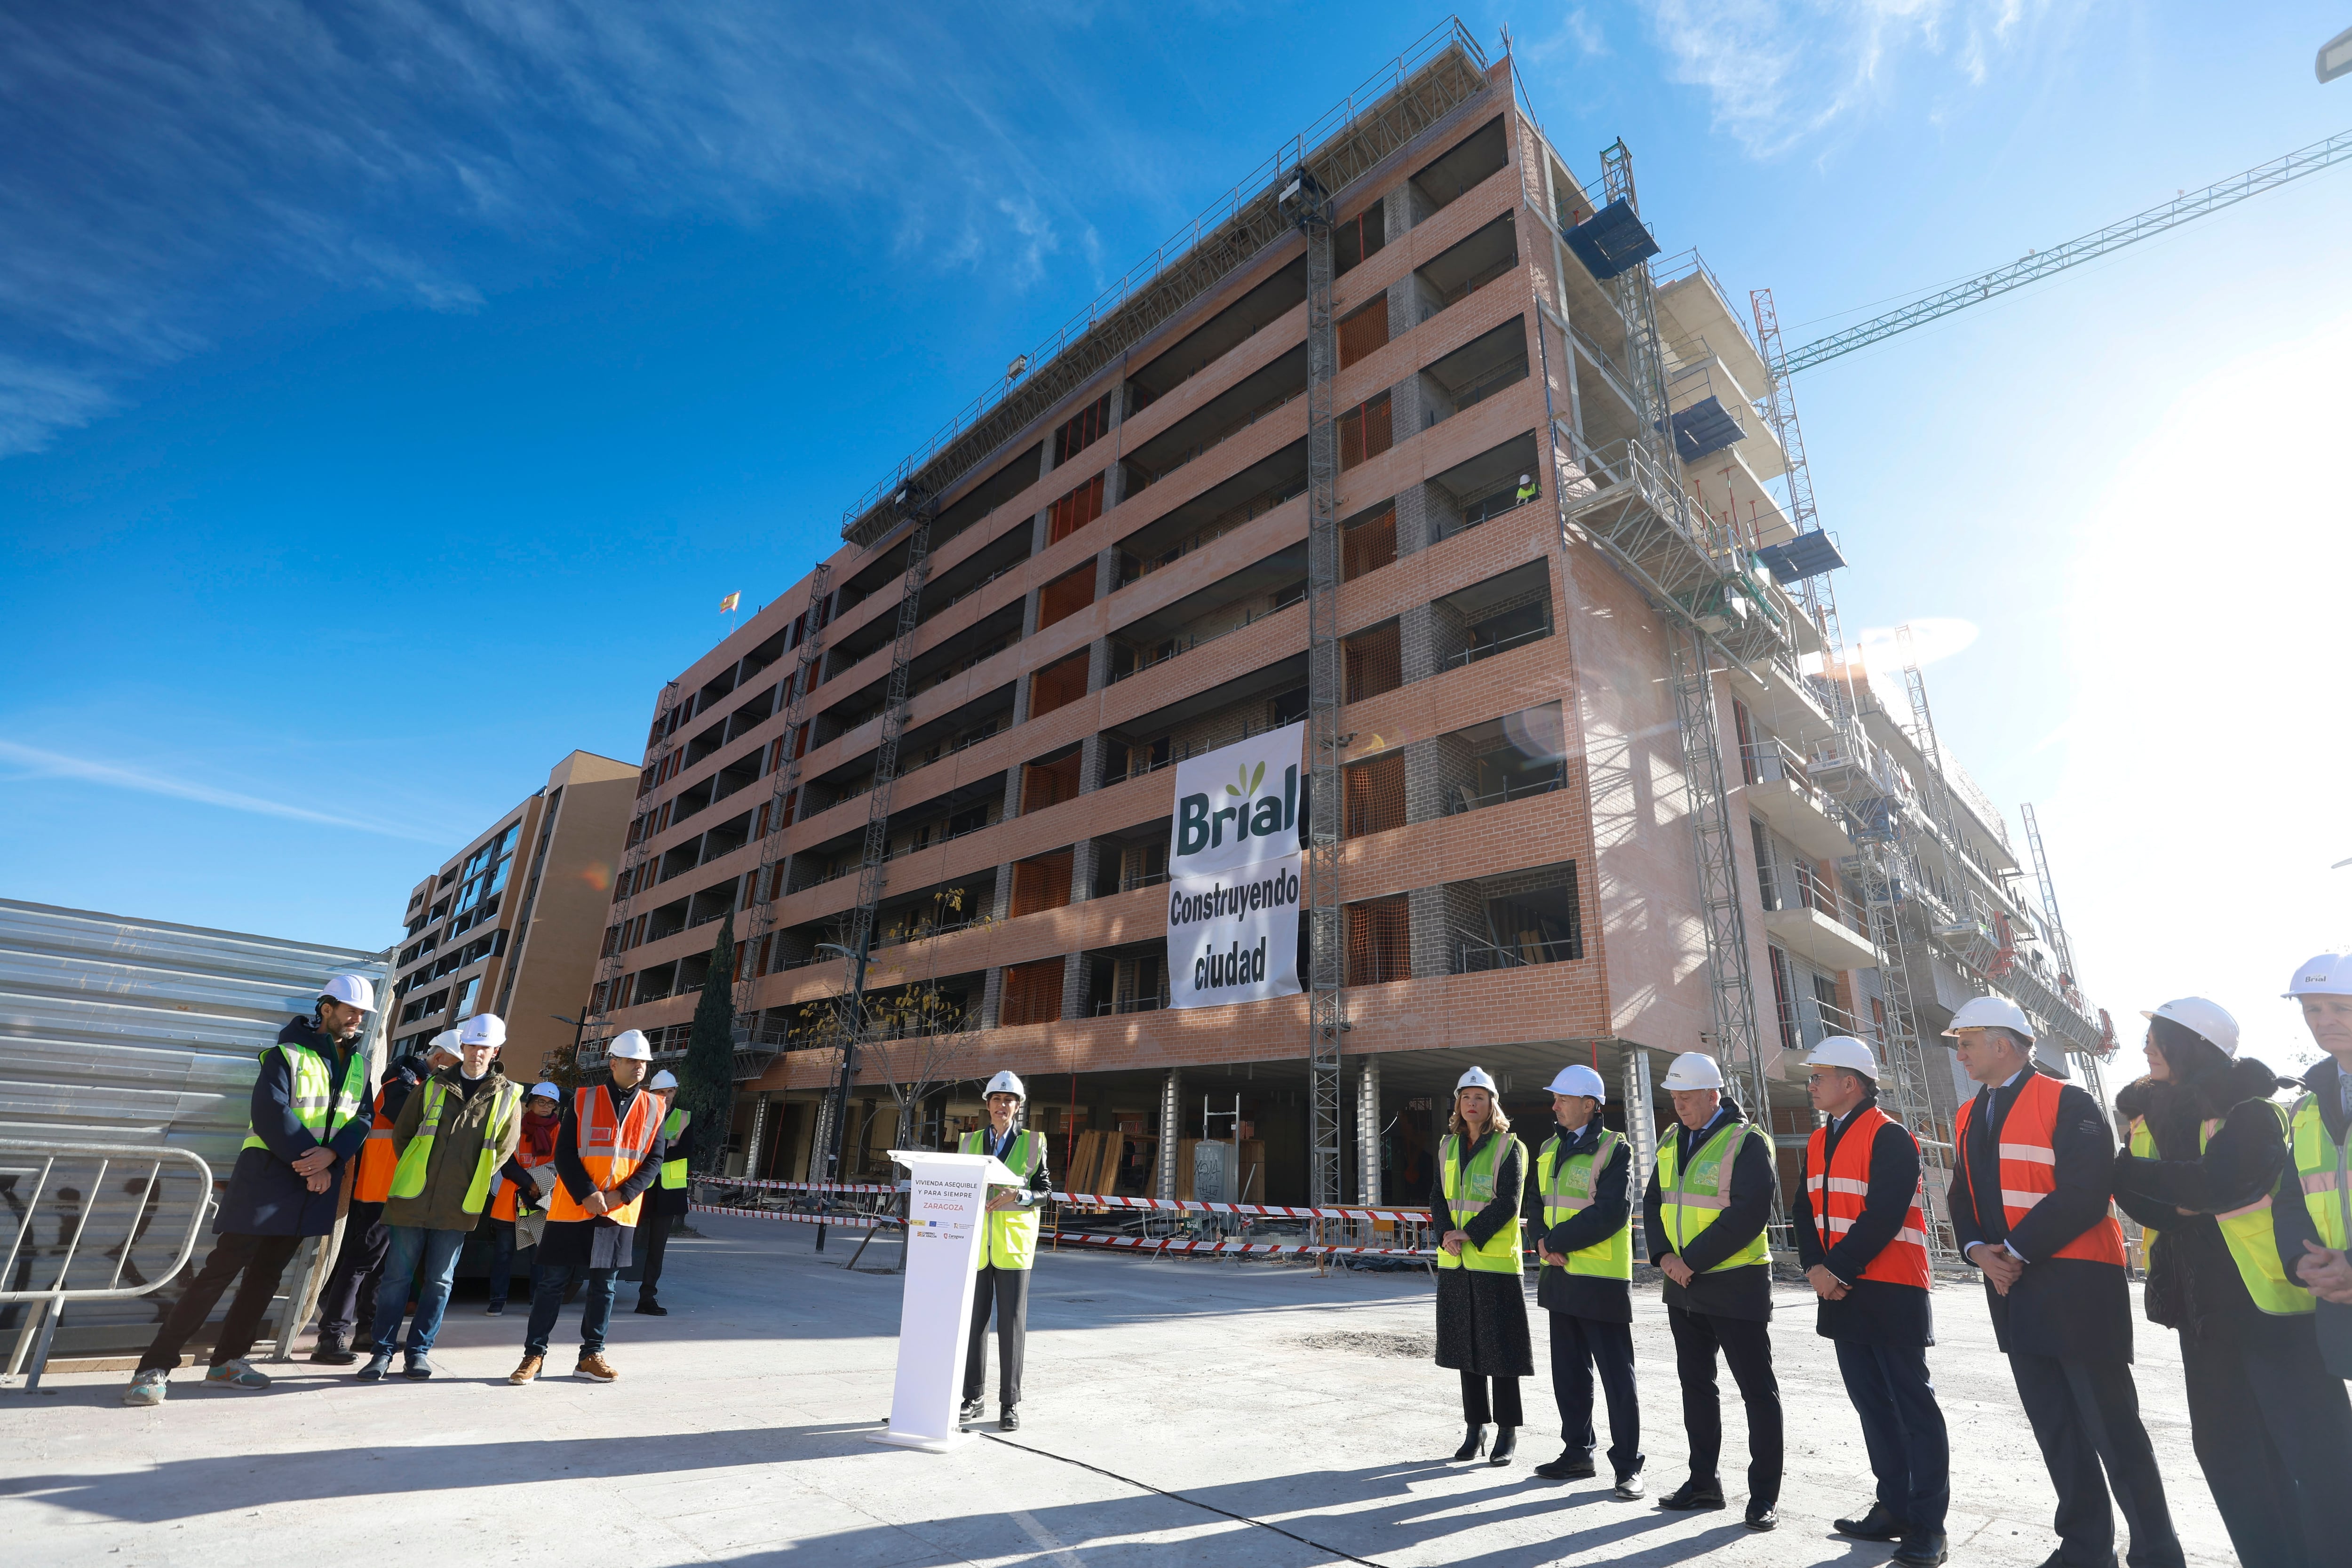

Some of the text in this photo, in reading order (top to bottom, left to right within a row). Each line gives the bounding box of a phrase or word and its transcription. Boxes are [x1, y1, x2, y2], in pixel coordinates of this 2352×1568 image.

[1177, 763, 1297, 857] Brial
[1171, 868, 1298, 926] Construyendo
[1195, 937, 1266, 991] ciudad
[923, 1202, 963, 1211] ZARAGOZA
